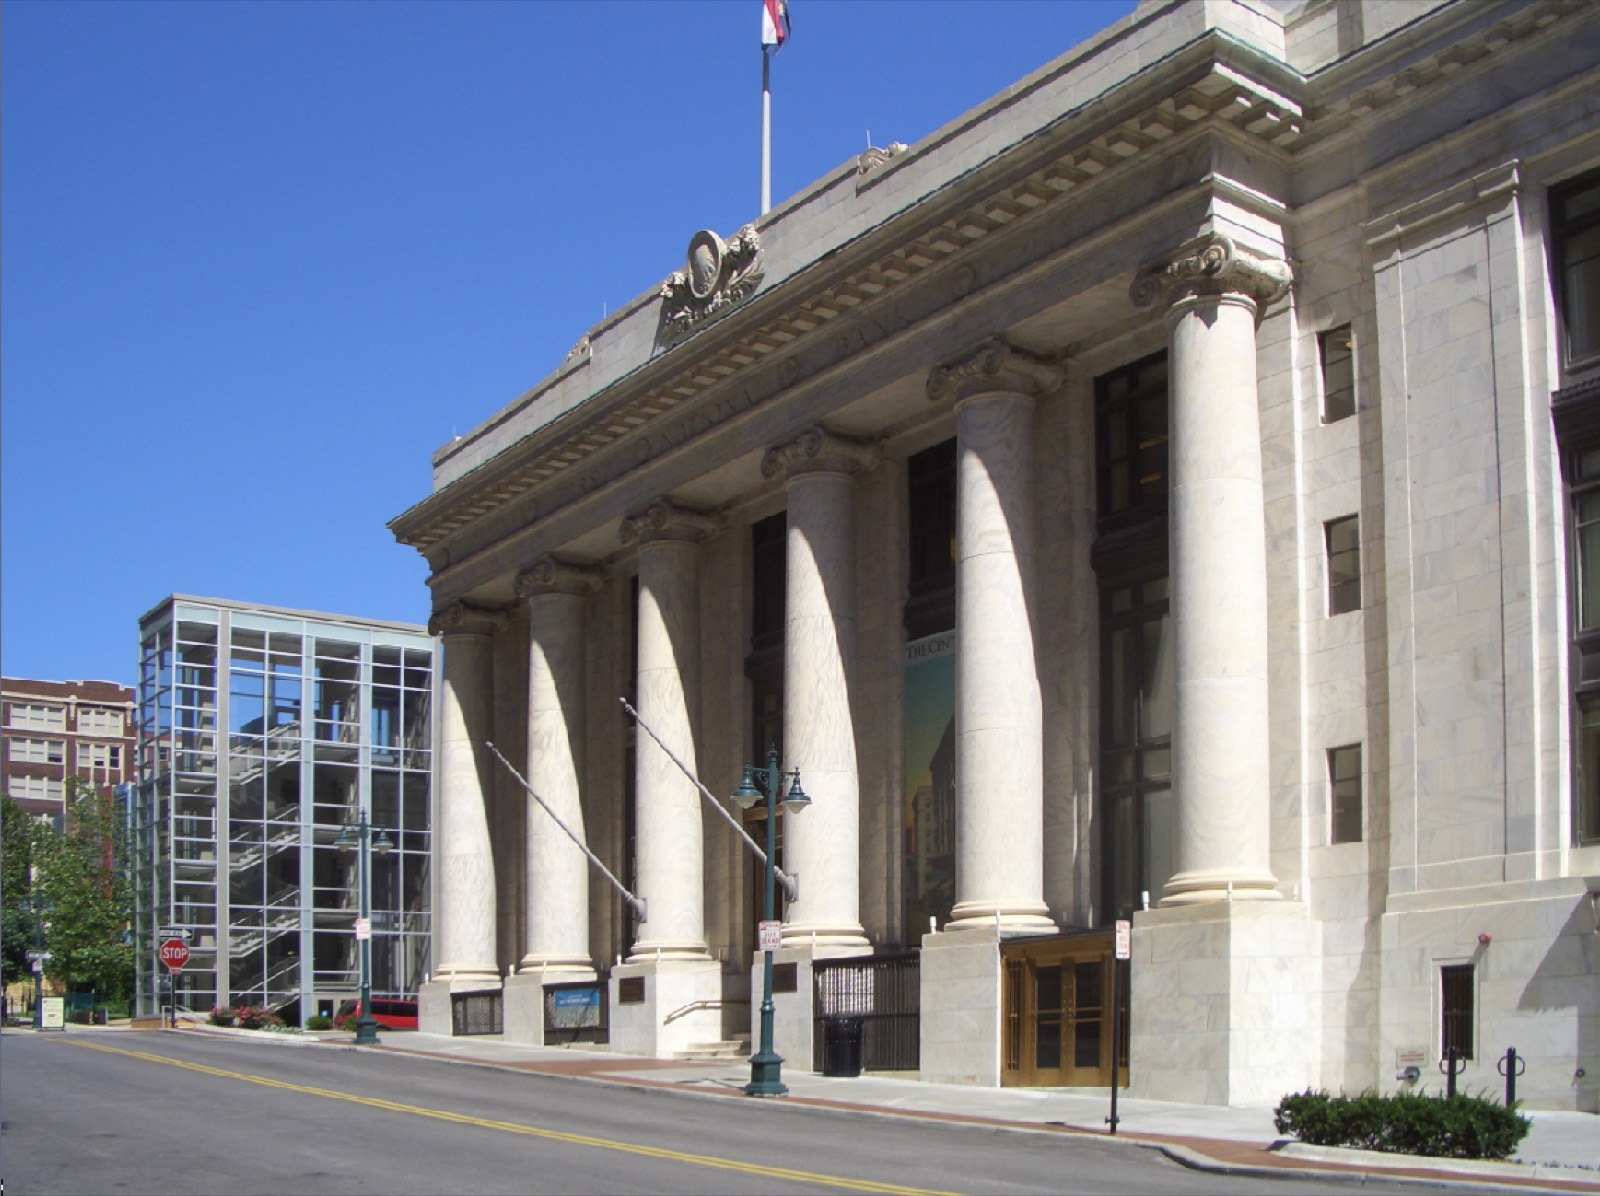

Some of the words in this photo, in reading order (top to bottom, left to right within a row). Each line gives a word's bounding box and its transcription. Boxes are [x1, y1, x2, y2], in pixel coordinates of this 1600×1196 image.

[905, 644, 928, 660] THE
[928, 634, 955, 654] CEN
[163, 947, 188, 959] STOP
